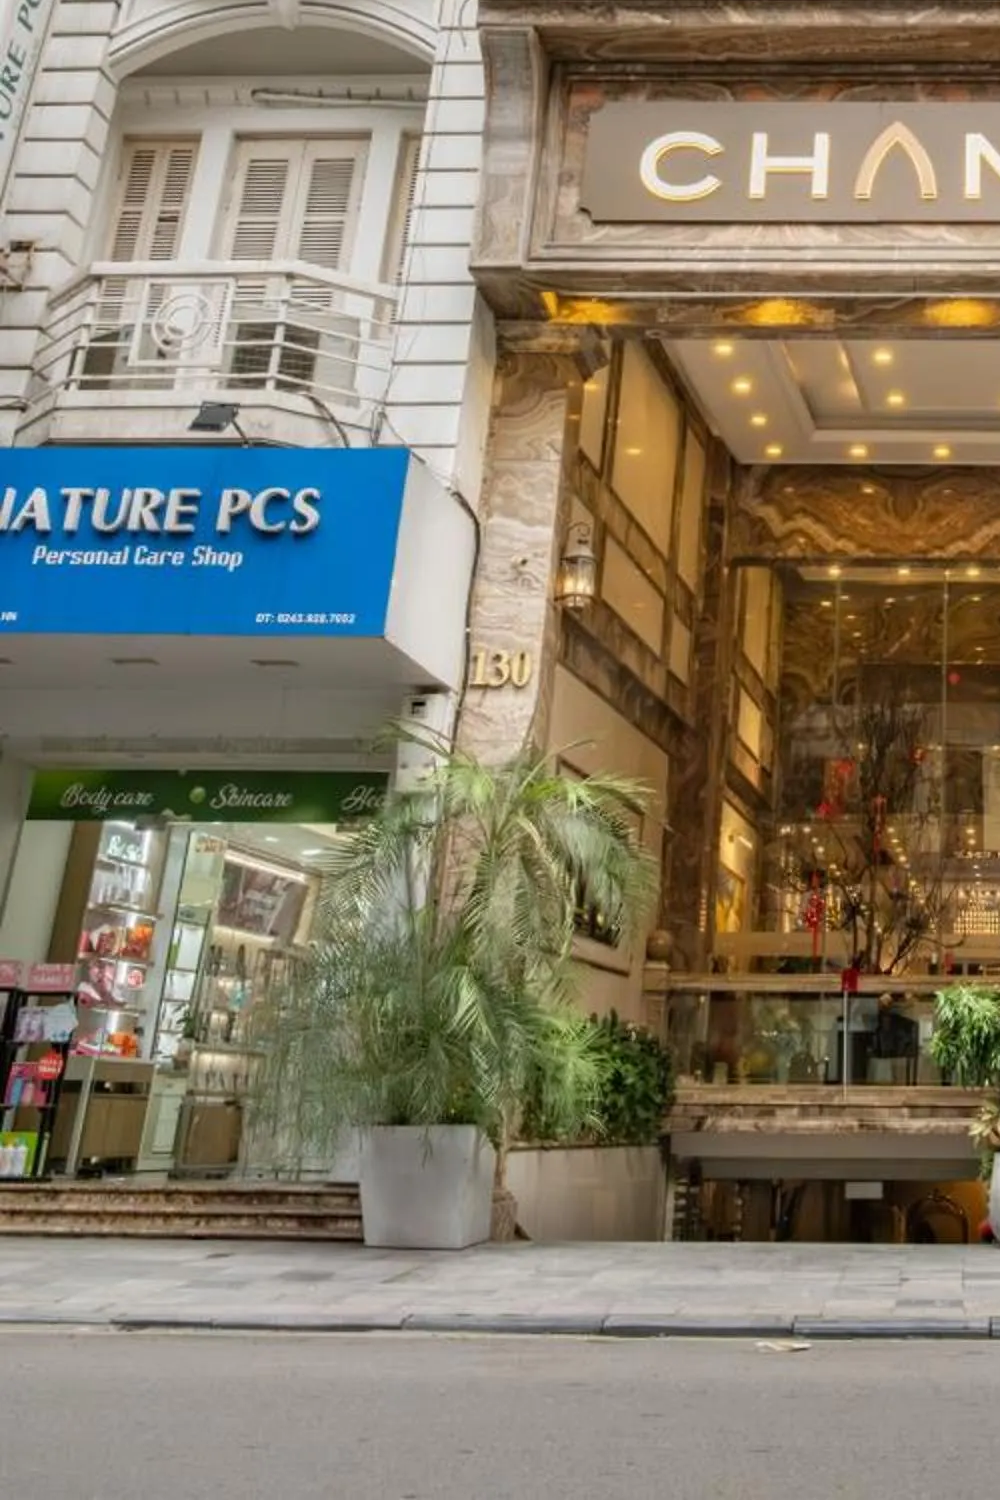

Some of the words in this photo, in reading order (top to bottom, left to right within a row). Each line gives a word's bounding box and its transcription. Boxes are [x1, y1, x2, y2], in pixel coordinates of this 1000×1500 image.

[0, 41, 27, 140] URE
[215, 487, 321, 533] PCS
[32, 545, 129, 566] Personal
[133, 546, 184, 567] Care
[191, 546, 243, 572] Shop
[470, 647, 532, 688] 130
[209, 783, 293, 809] Skincare
